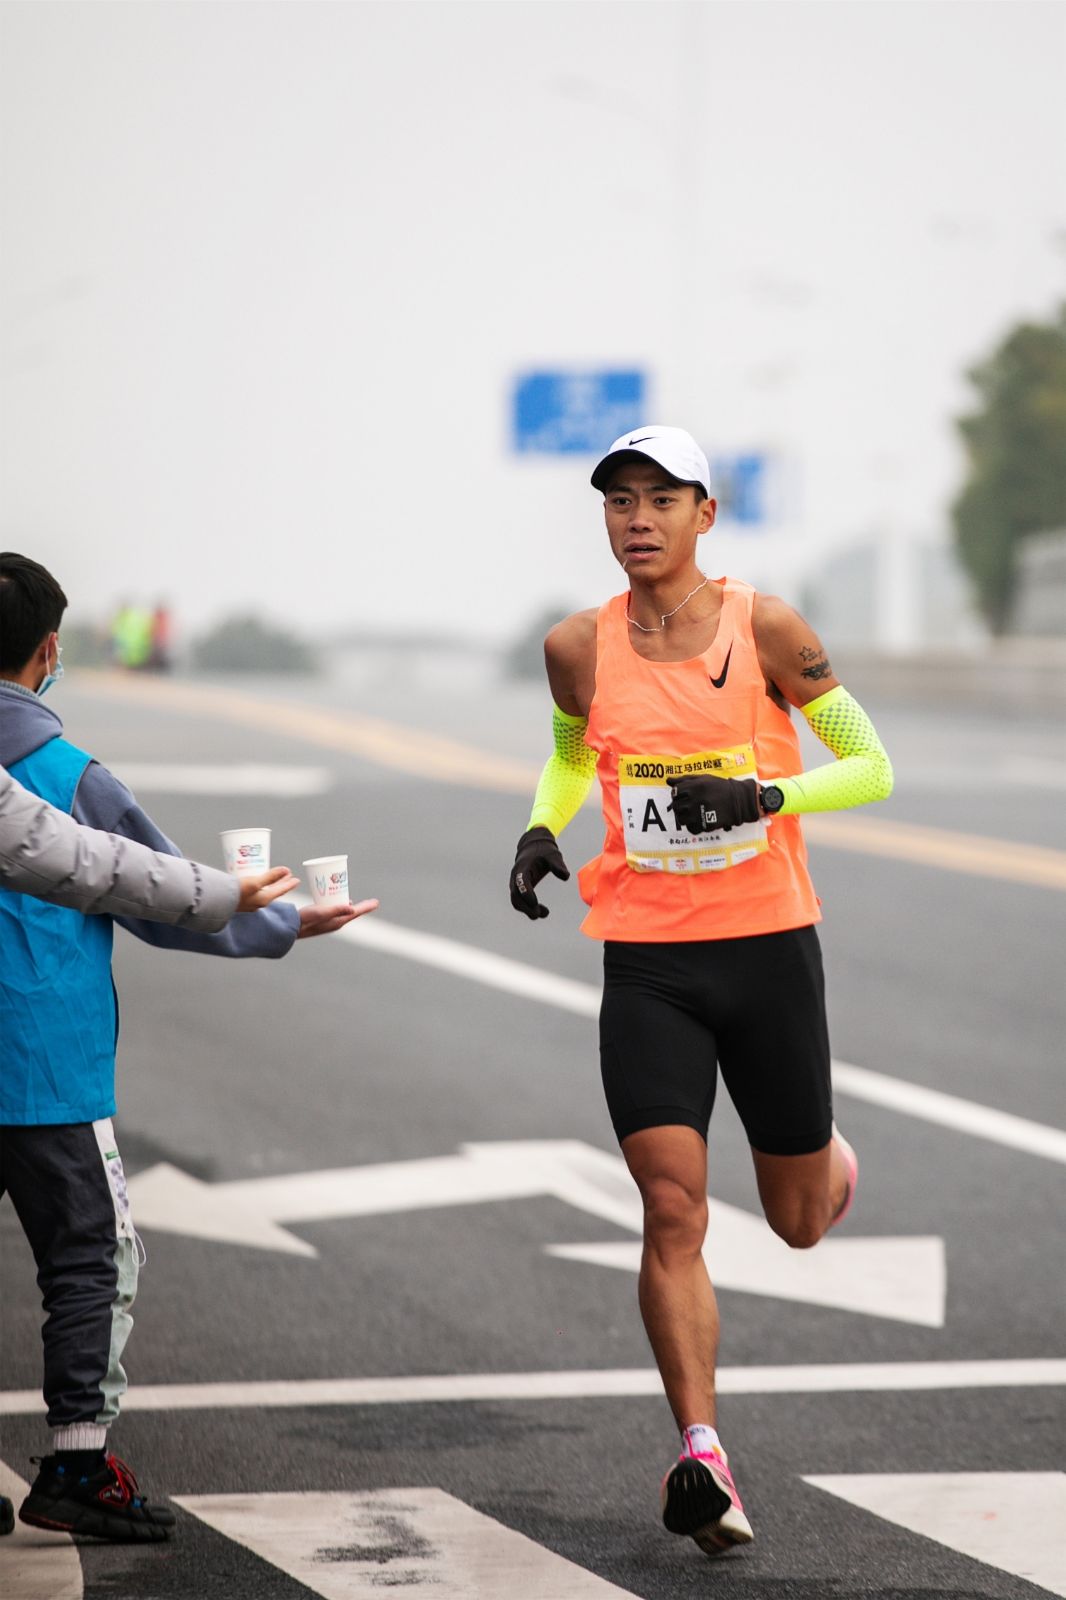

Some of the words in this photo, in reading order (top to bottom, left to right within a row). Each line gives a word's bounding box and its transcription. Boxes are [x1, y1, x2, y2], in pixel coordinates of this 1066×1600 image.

[634, 763, 664, 778] 2020
[665, 759, 722, 774] 湘江马拉松赛
